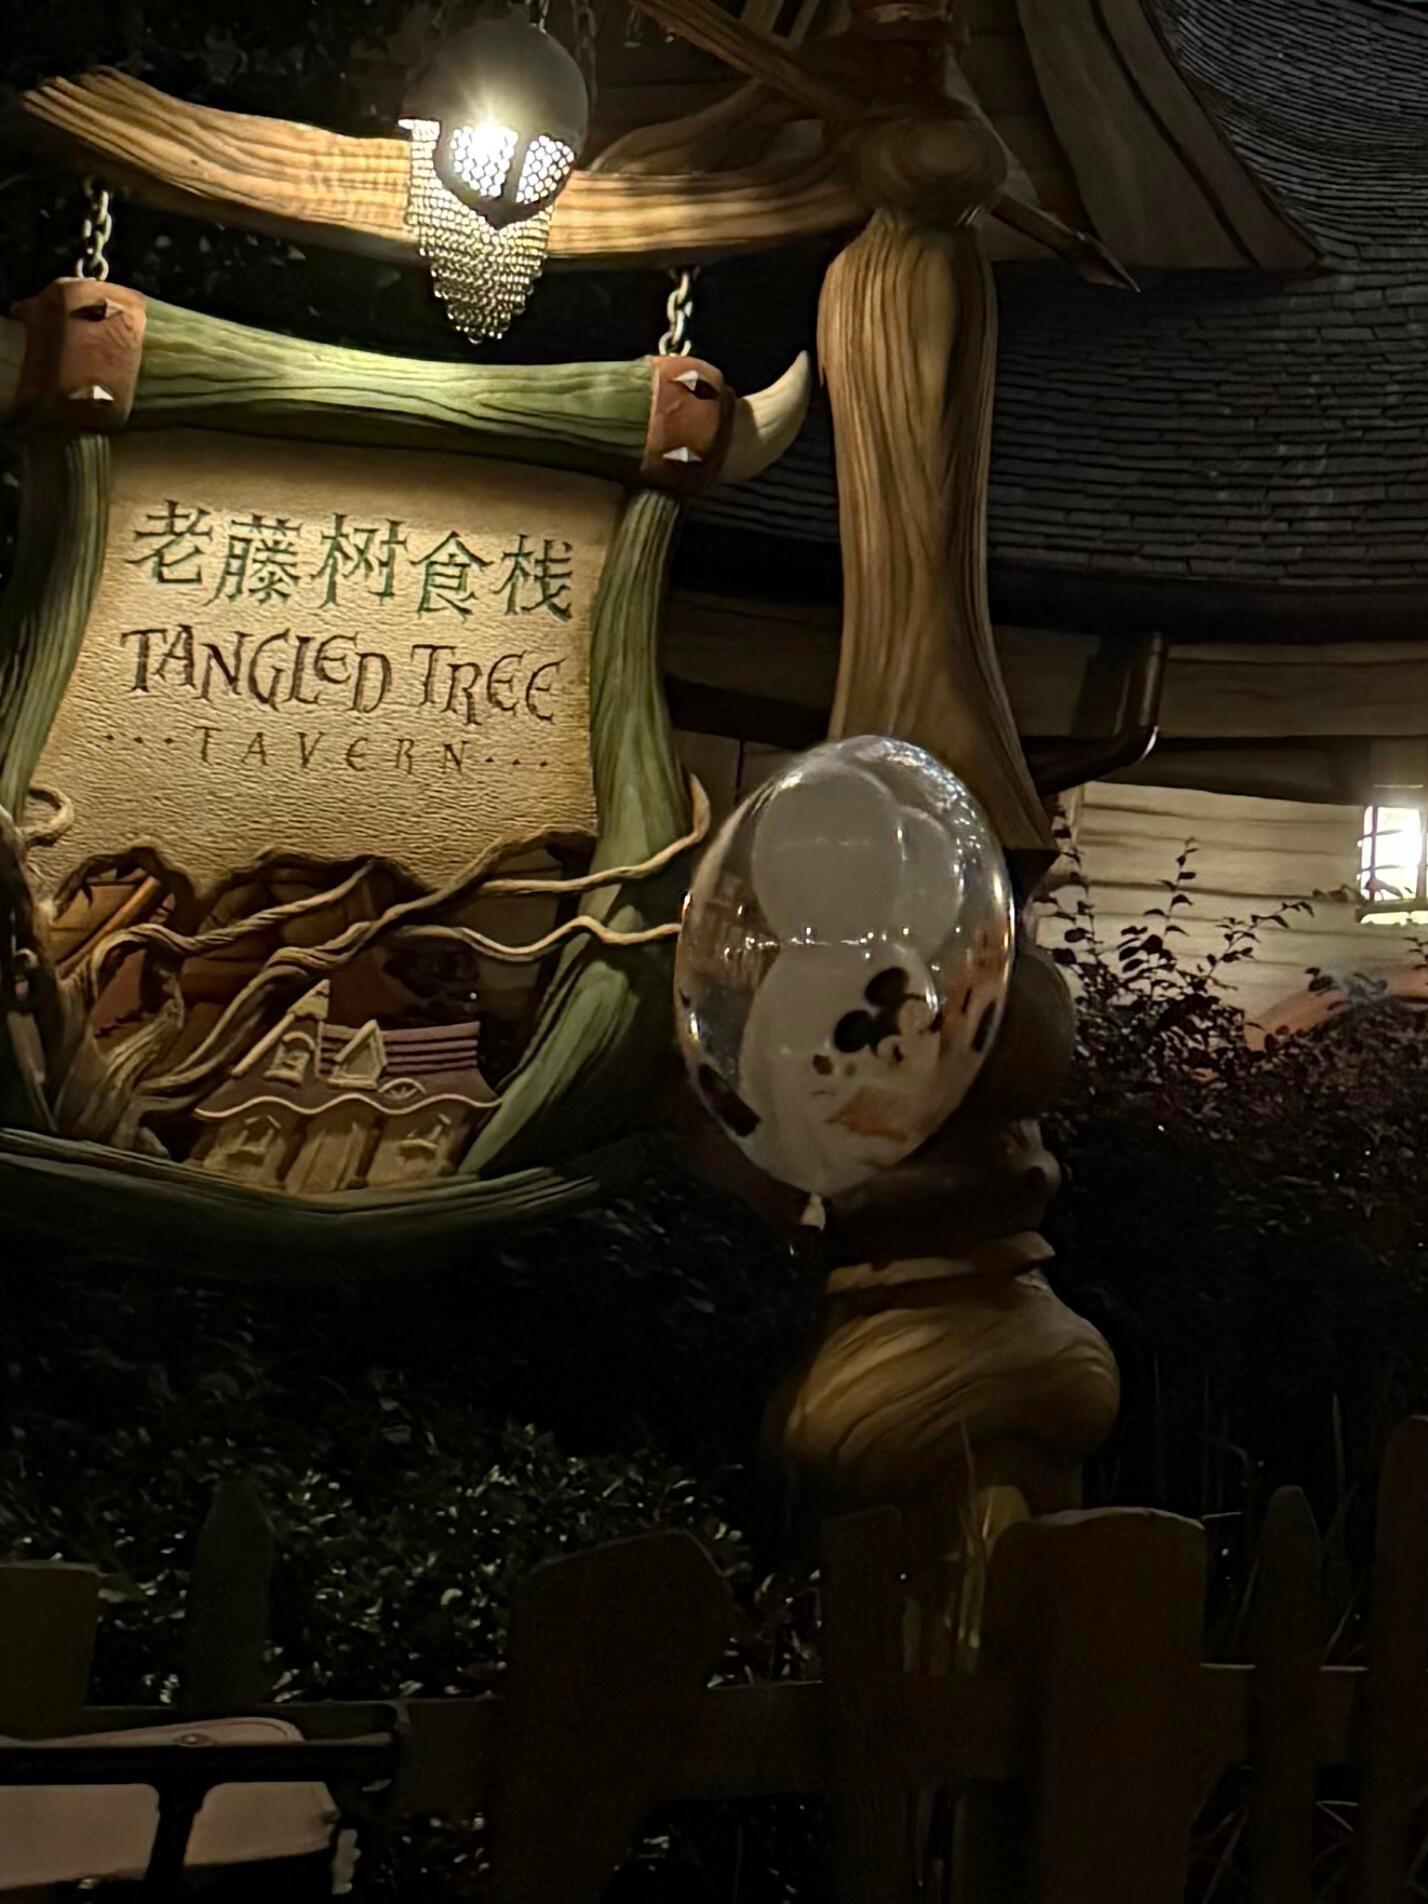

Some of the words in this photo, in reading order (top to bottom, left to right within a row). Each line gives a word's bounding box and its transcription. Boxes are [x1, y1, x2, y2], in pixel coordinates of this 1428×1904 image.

[124, 499, 574, 622] 老藤树食栈
[120, 624, 393, 714] TANGLED
[410, 644, 566, 726] TREE
